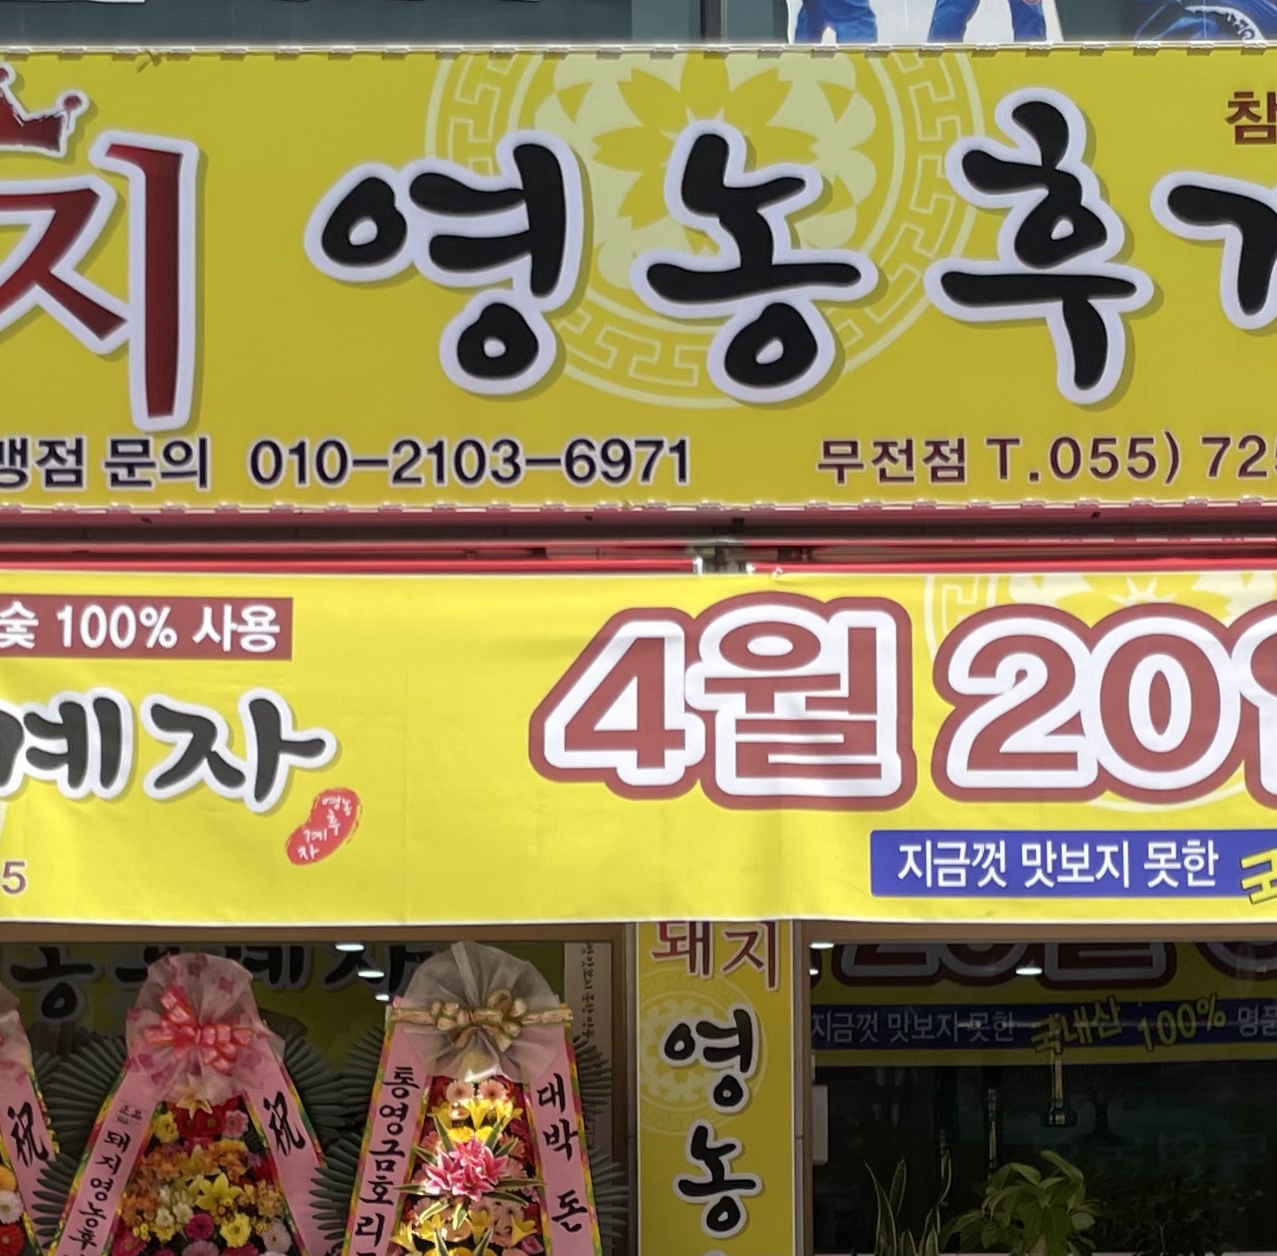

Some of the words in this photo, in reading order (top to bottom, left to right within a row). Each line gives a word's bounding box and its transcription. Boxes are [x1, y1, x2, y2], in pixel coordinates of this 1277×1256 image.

[104, 436, 210, 489] 문의
[249, 437, 692, 486] 010-2103-6971
[817, 436, 968, 486] 무전점
[57, 603, 179, 652] 100%
[192, 603, 282, 655] 사용
[542, 600, 905, 800] 4월
[896, 838, 1009, 890] 지금껏
[1019, 838, 1134, 890] 맛보지
[1142, 838, 1220, 889] 못한
[651, 921, 777, 989] 돼지
[1137, 991, 1228, 1054] 100%
[7, 1100, 50, 1168] 祝
[262, 1090, 306, 1157] 祝
[535, 1072, 579, 1162] 대박
[550, 1191, 589, 1234] 돈
